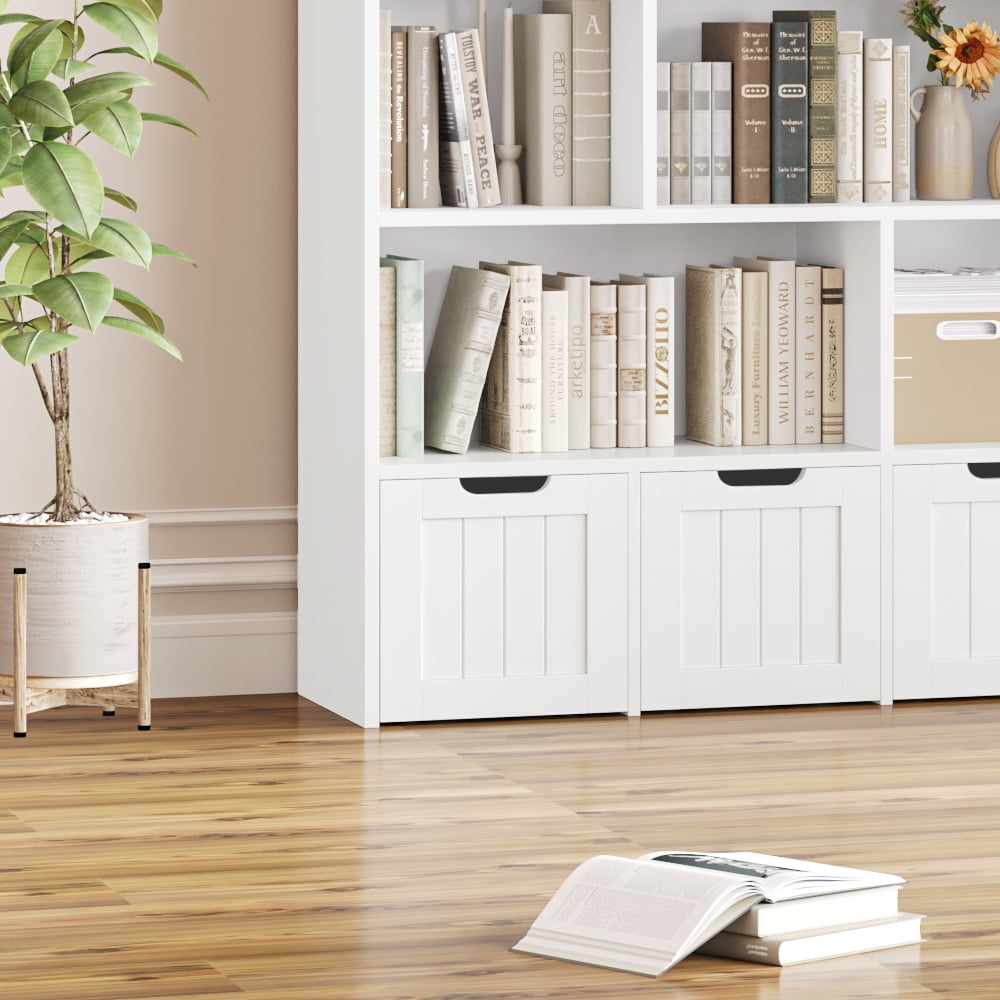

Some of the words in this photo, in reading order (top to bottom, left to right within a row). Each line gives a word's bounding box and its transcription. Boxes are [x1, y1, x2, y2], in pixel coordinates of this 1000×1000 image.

[584, 15, 602, 35] A
[461, 34, 478, 73] TOLSTOY
[396, 95, 404, 142] Revolution
[468, 78, 483, 120] WAR
[873, 98, 887, 149] HOME
[475, 135, 492, 191] PEACE
[552, 105, 568, 178] deco
[778, 281, 789, 356] YEOWARD
[568, 325, 586, 399] arketipo
[751, 330, 761, 389] Furniture
[751, 394, 762, 435] Luxury
[778, 361, 789, 425] WILLIAM
